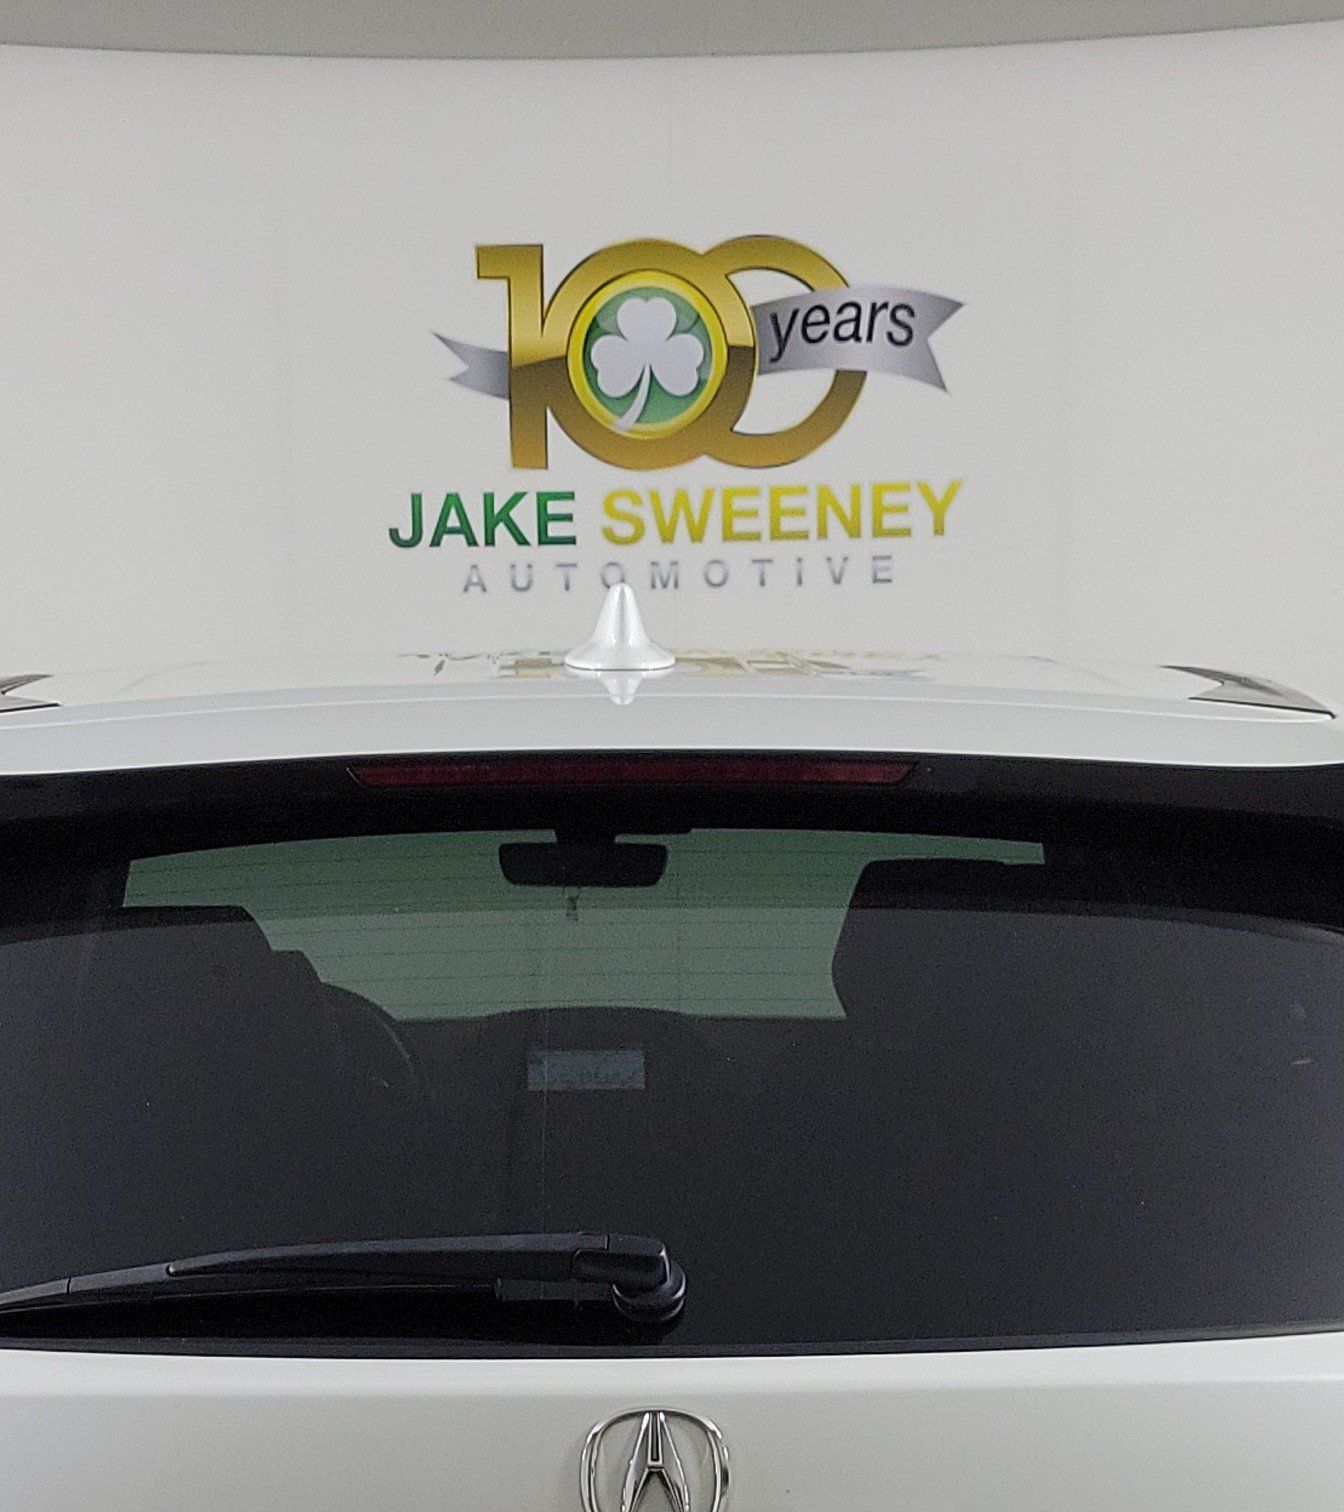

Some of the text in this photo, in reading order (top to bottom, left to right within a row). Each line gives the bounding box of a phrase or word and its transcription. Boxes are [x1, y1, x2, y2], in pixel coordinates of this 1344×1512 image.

[768, 299, 916, 363] years
[388, 479, 962, 549] JAKE SWEENEY
[462, 554, 894, 595] AUTOMOTIVE
